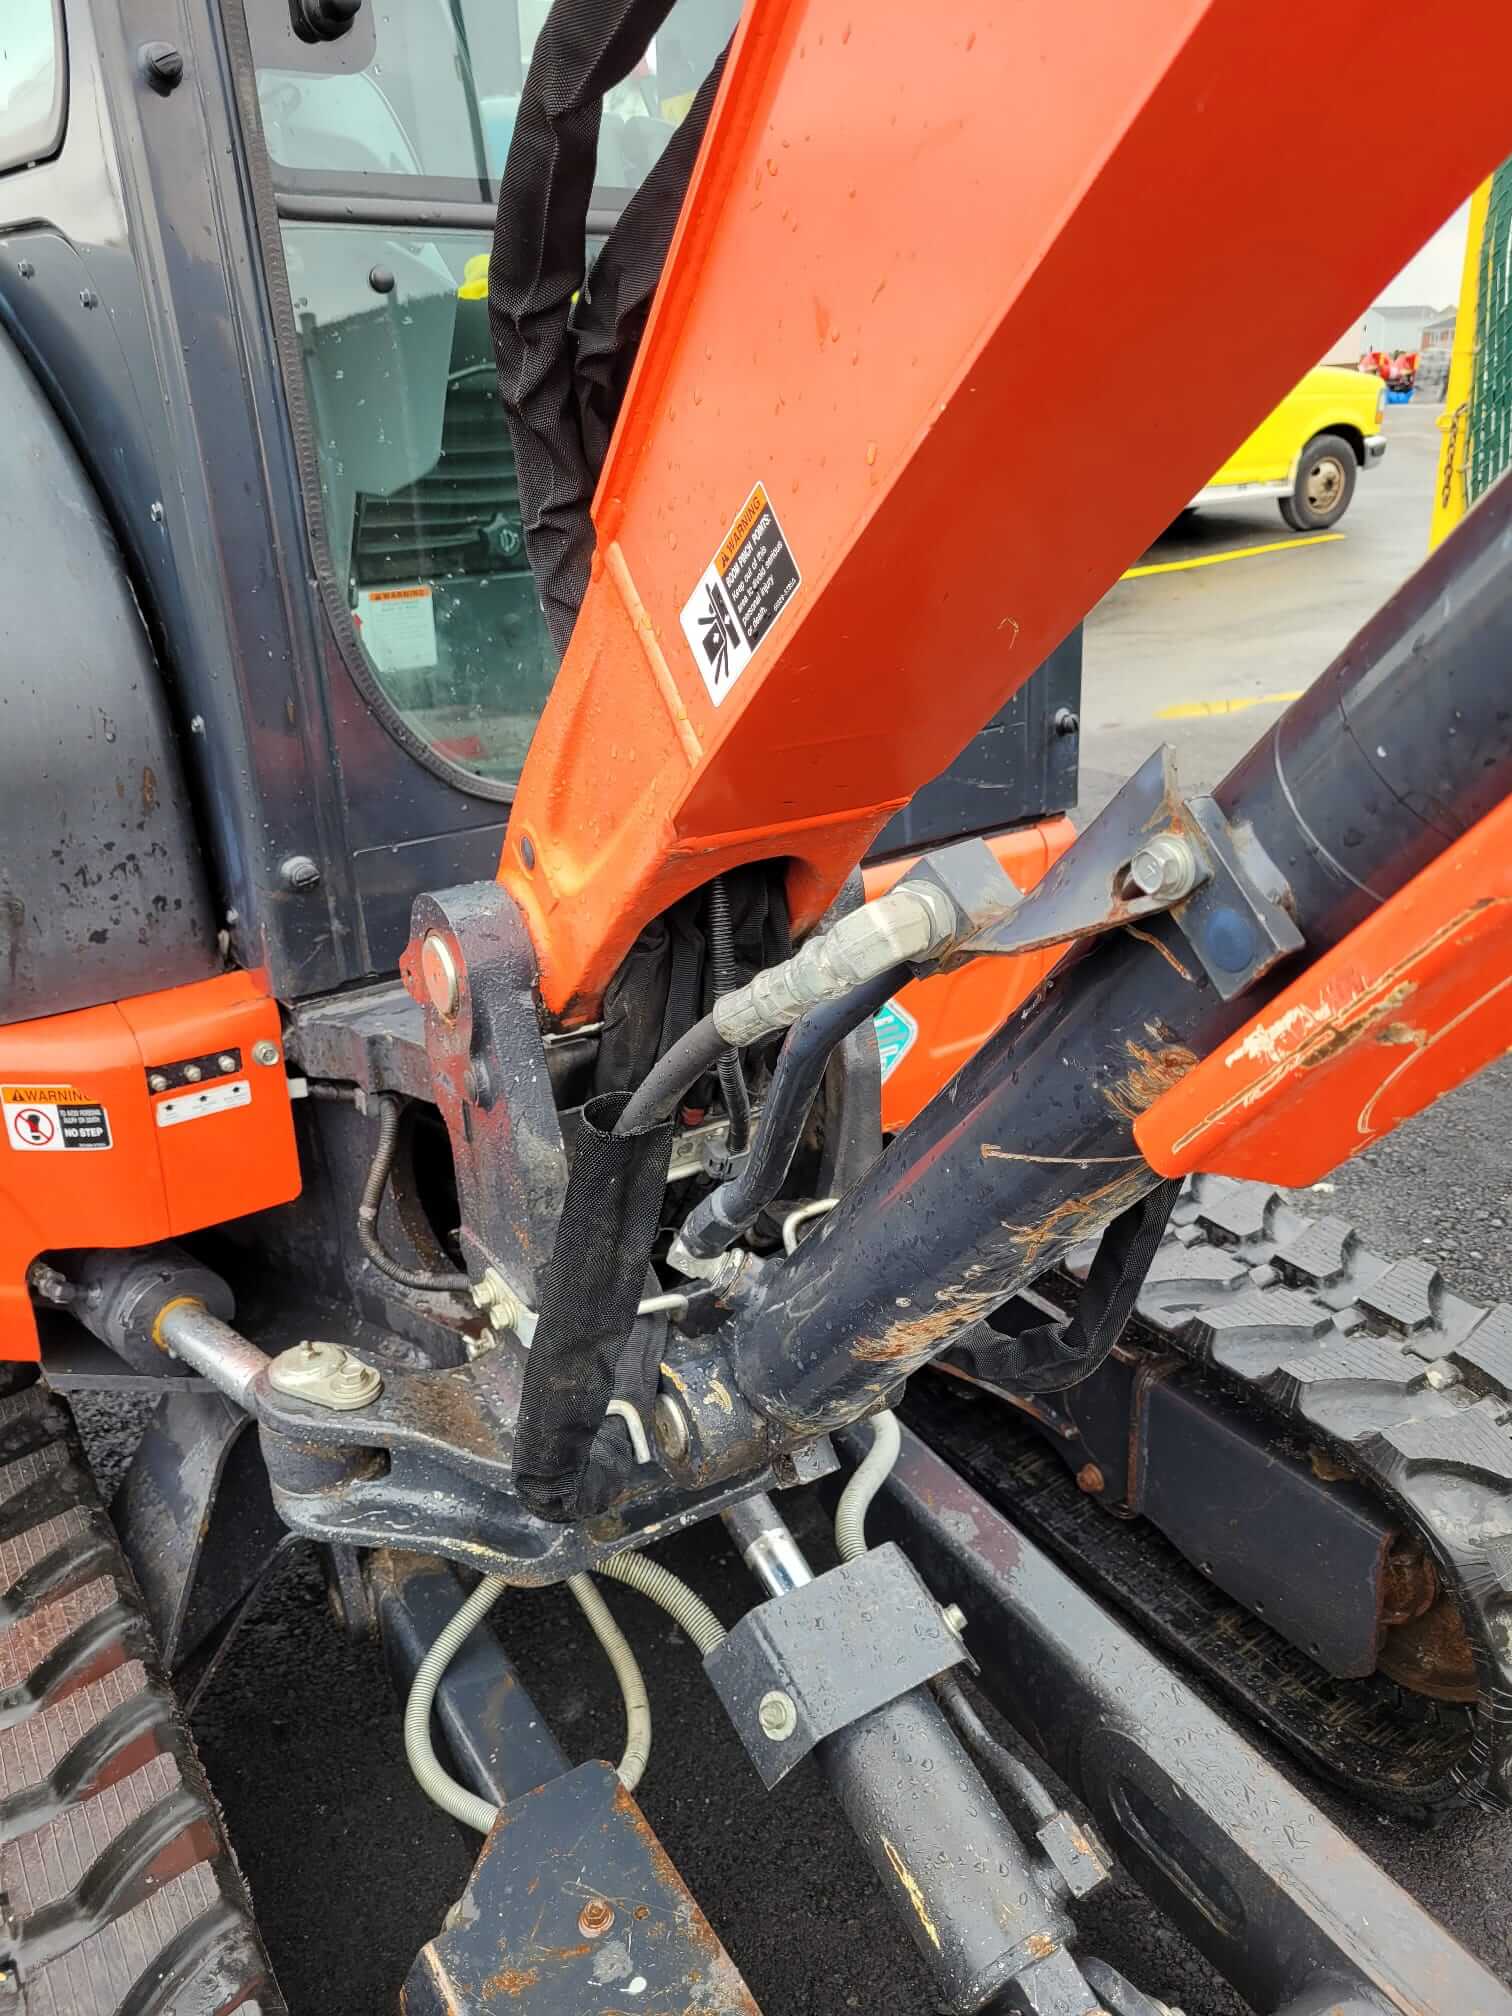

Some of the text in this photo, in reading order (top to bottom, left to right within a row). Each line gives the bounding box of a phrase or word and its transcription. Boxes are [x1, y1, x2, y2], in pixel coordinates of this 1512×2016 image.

[727, 496, 761, 553] WARNING
[726, 562, 740, 589] BOOM
[738, 540, 754, 568] PINCH
[732, 545, 767, 602] Keep out of this
[738, 541, 783, 614] area to avoid serious
[743, 574, 774, 628] personal injury
[64, 1126, 104, 1138] NO STEP
